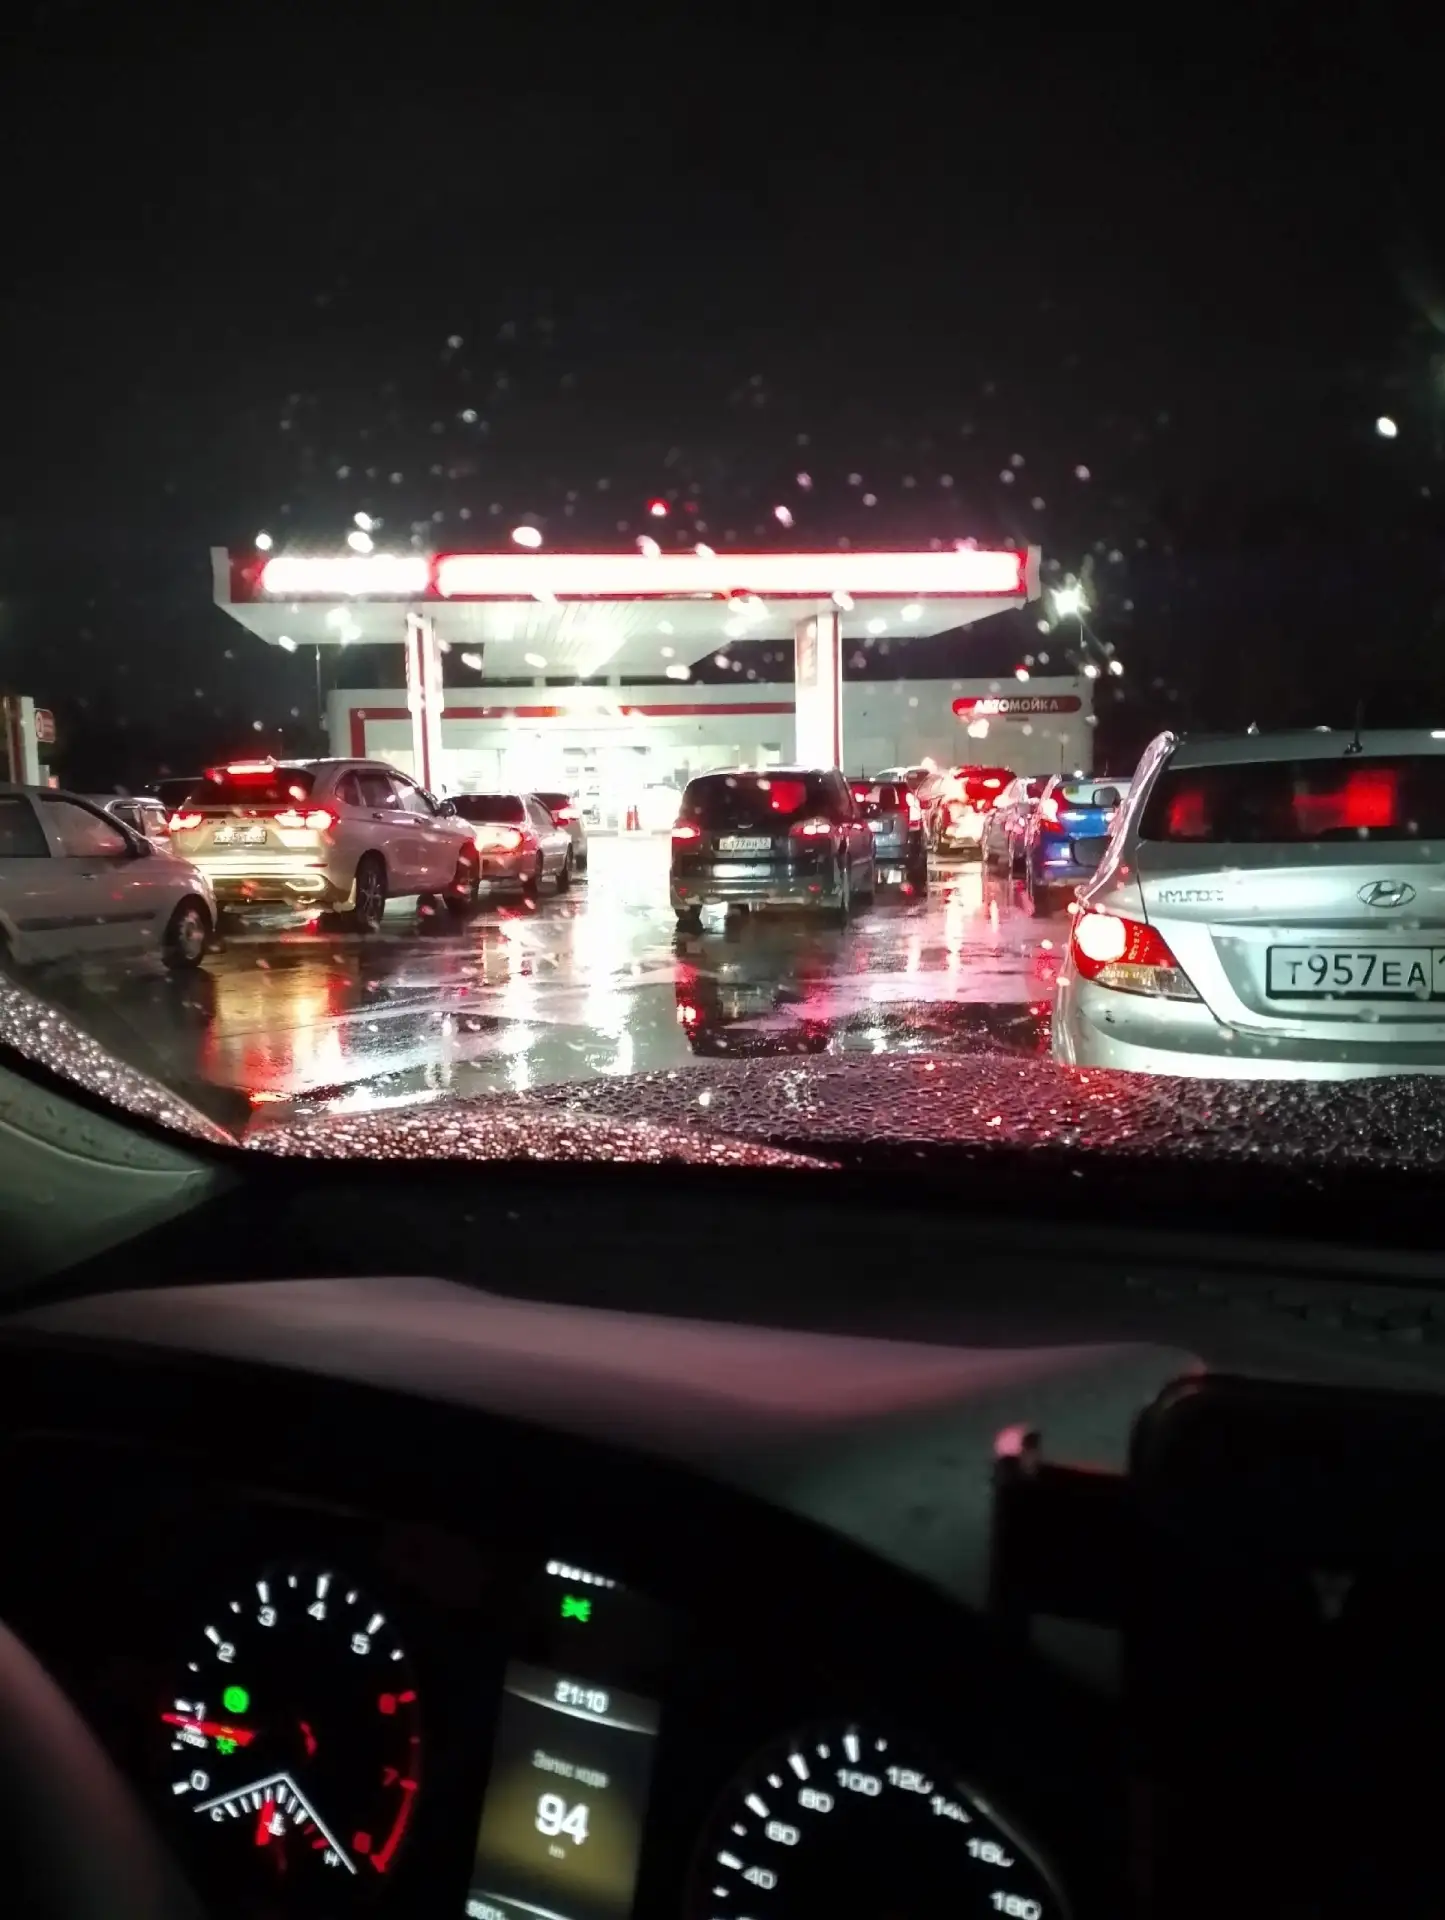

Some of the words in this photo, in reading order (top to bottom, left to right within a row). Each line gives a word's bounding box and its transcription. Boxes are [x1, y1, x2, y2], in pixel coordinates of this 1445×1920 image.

[1284, 954, 1426, 987] Т957ЕА
[257, 1604, 277, 1627] 3
[307, 1600, 327, 1621] 4
[216, 1642, 236, 1663] 2
[351, 1632, 371, 1655] 5
[555, 1680, 609, 1714] 21:10
[194, 1702, 206, 1721] 1
[190, 1769, 210, 1791] 0
[836, 1768, 882, 1796] 100
[798, 1787, 834, 1813] 80
[535, 1793, 590, 1845] 94
[742, 1866, 778, 1890] 40
[990, 1891, 1042, 1920] 180
